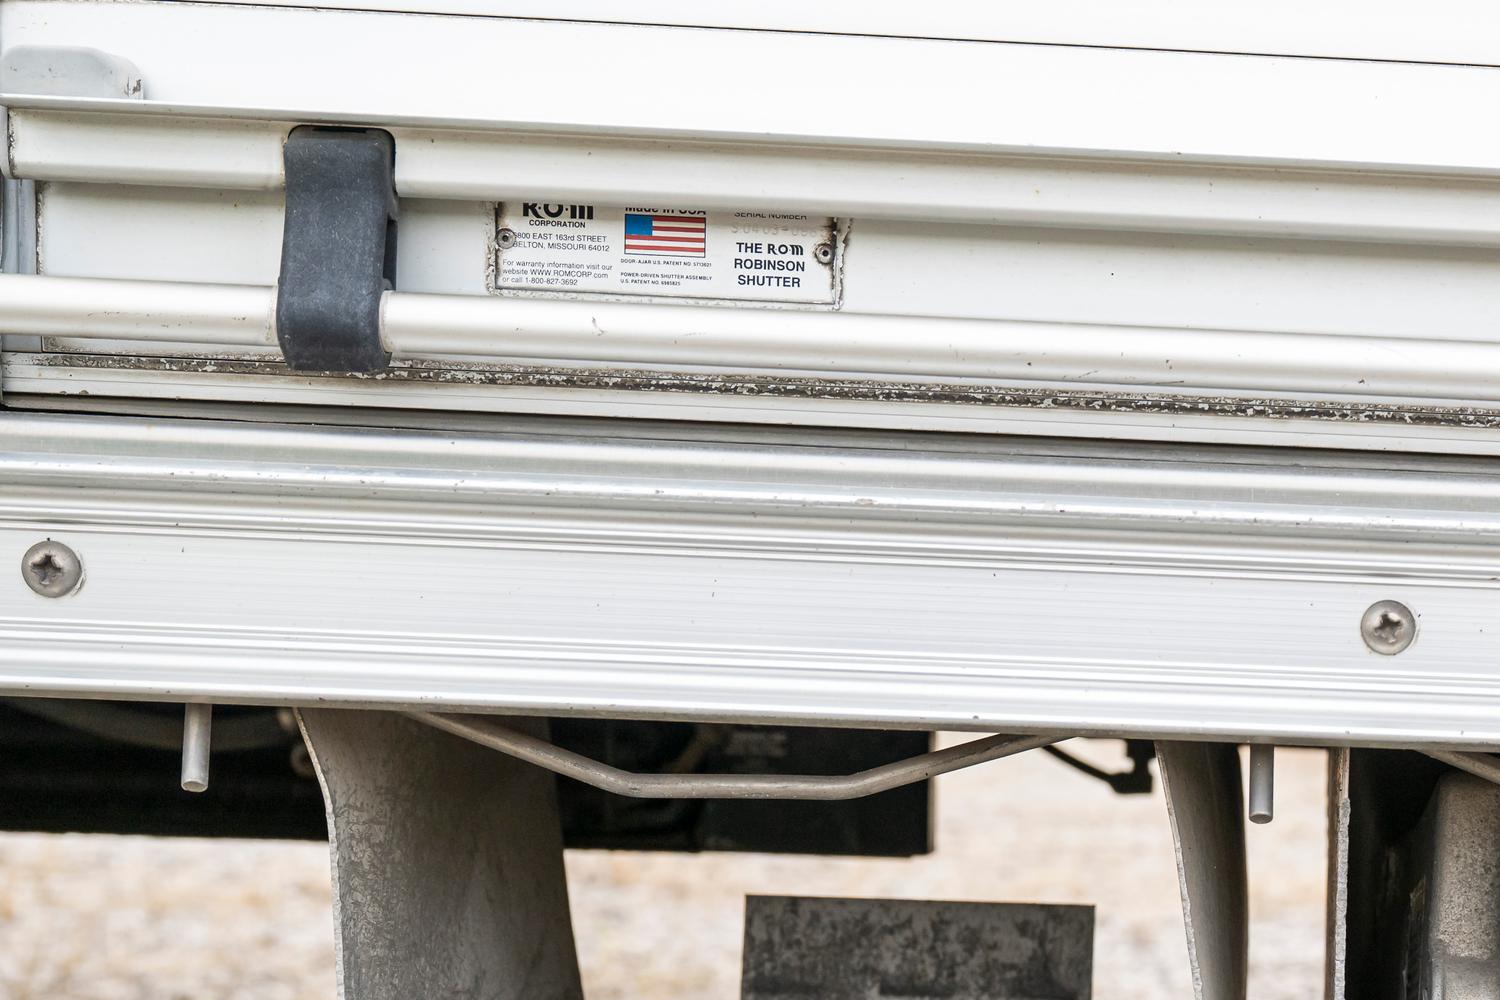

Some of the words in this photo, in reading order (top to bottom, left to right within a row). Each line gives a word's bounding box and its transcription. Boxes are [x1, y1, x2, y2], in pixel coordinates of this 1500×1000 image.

[529, 219, 586, 228] CORPORATION
[532, 232, 553, 240] EAST
[555, 233, 575, 241] 163rd
[576, 234, 607, 243] STREET
[512, 240, 546, 250] BELTON,
[547, 242, 587, 251] MISSOURI
[588, 244, 610, 252] 64012
[735, 242, 763, 254] THE
[515, 261, 544, 269] warranty
[546, 261, 585, 269] information
[733, 258, 805, 272] ROBINSON
[502, 267, 529, 275] website
[620, 271, 660, 279] POWER-DRIVEN
[525, 277, 578, 286] 1-800-827-3692
[737, 274, 801, 288] SHUTTER
